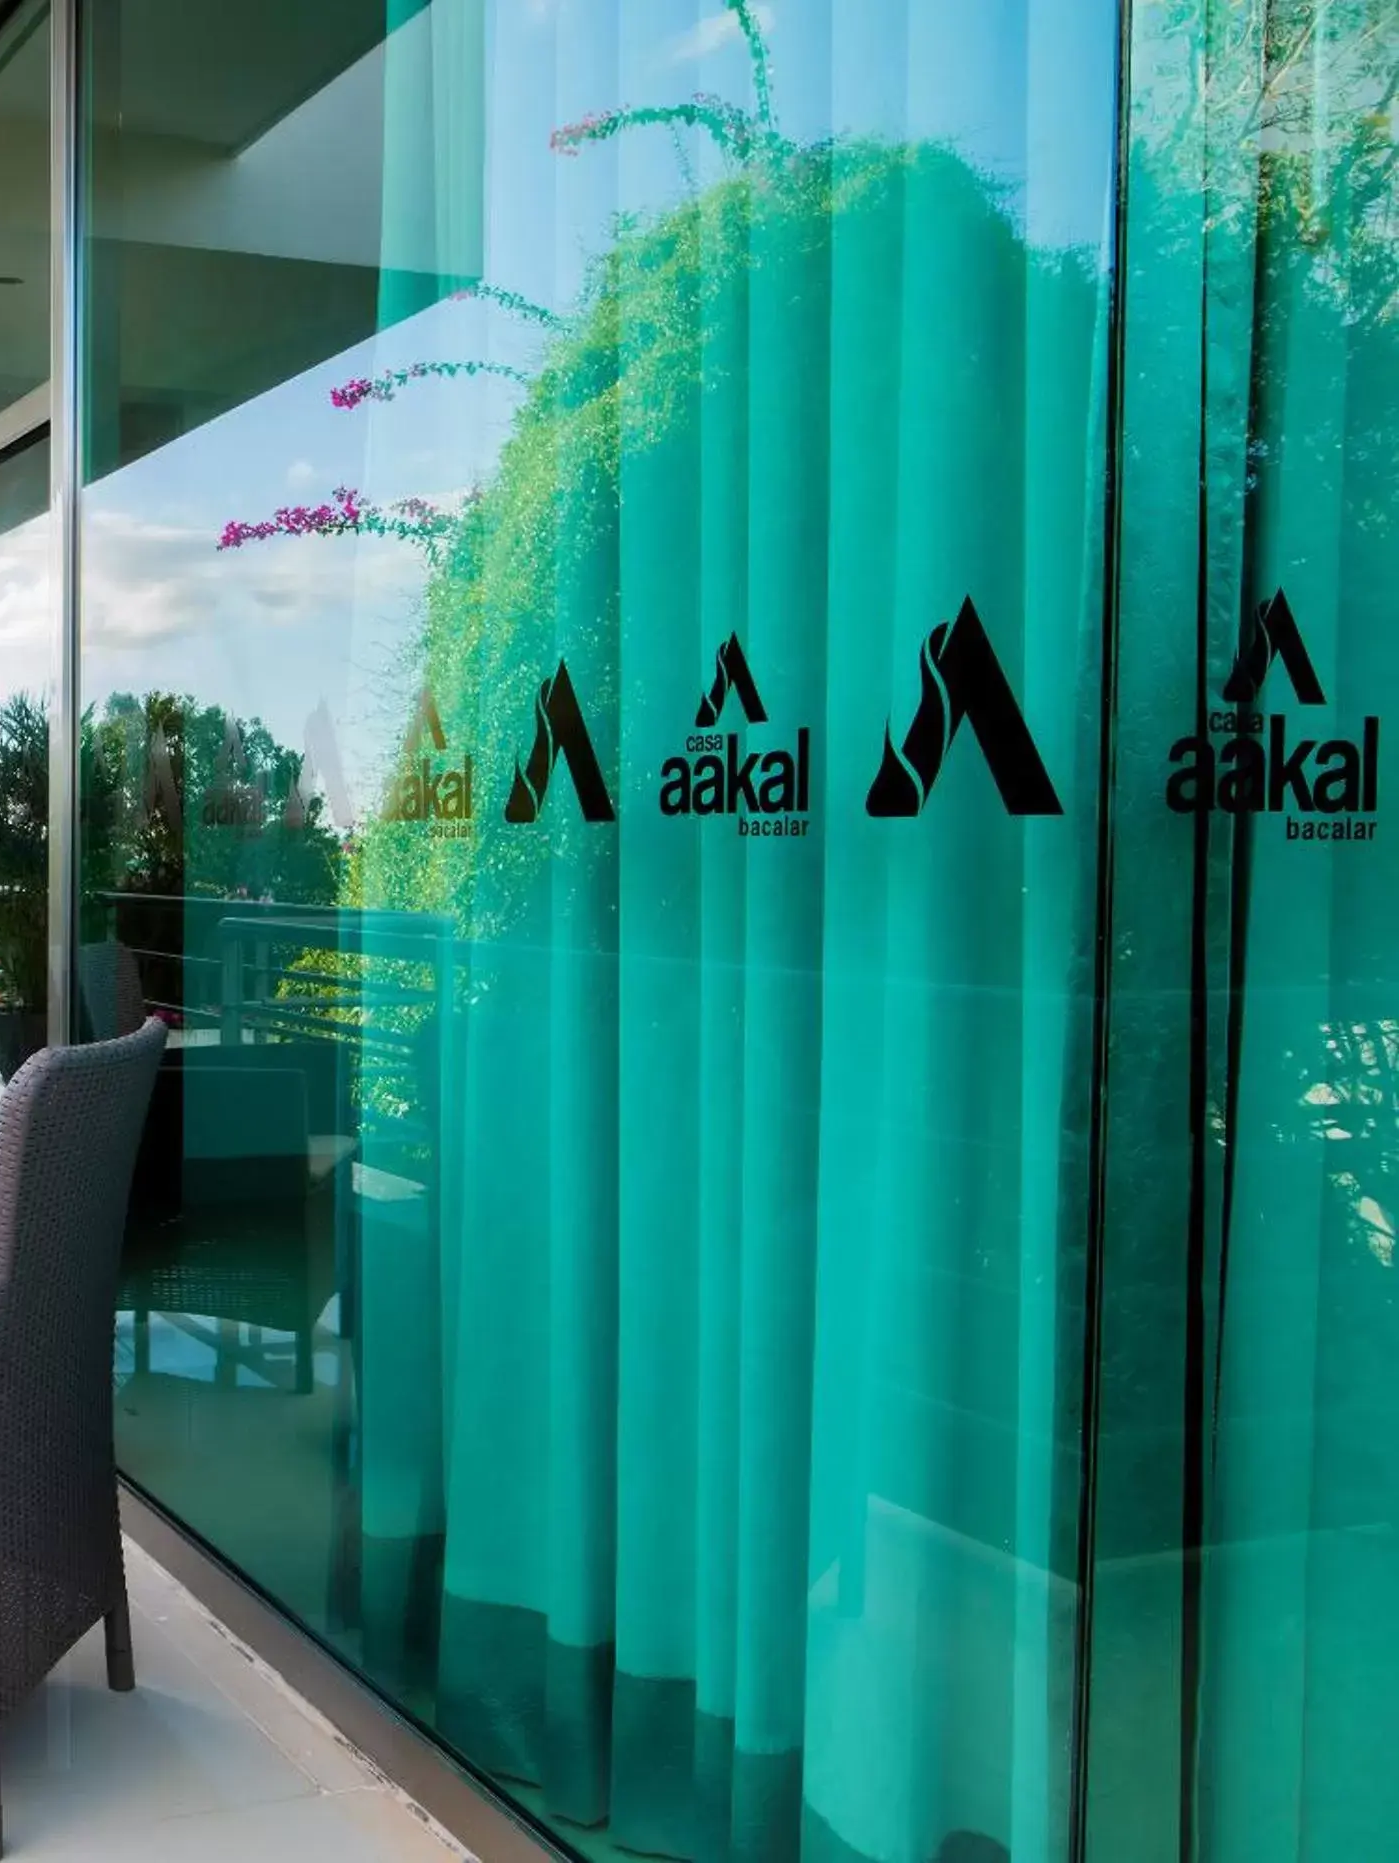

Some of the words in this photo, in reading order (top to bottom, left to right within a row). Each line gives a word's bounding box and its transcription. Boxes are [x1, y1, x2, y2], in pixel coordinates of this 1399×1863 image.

[1209, 712, 1264, 734] caa
[686, 734, 723, 752] casa
[660, 728, 809, 816] aakal
[1166, 714, 1379, 813] aakal
[738, 816, 810, 836] bacalar
[1286, 816, 1377, 840] bacalar
